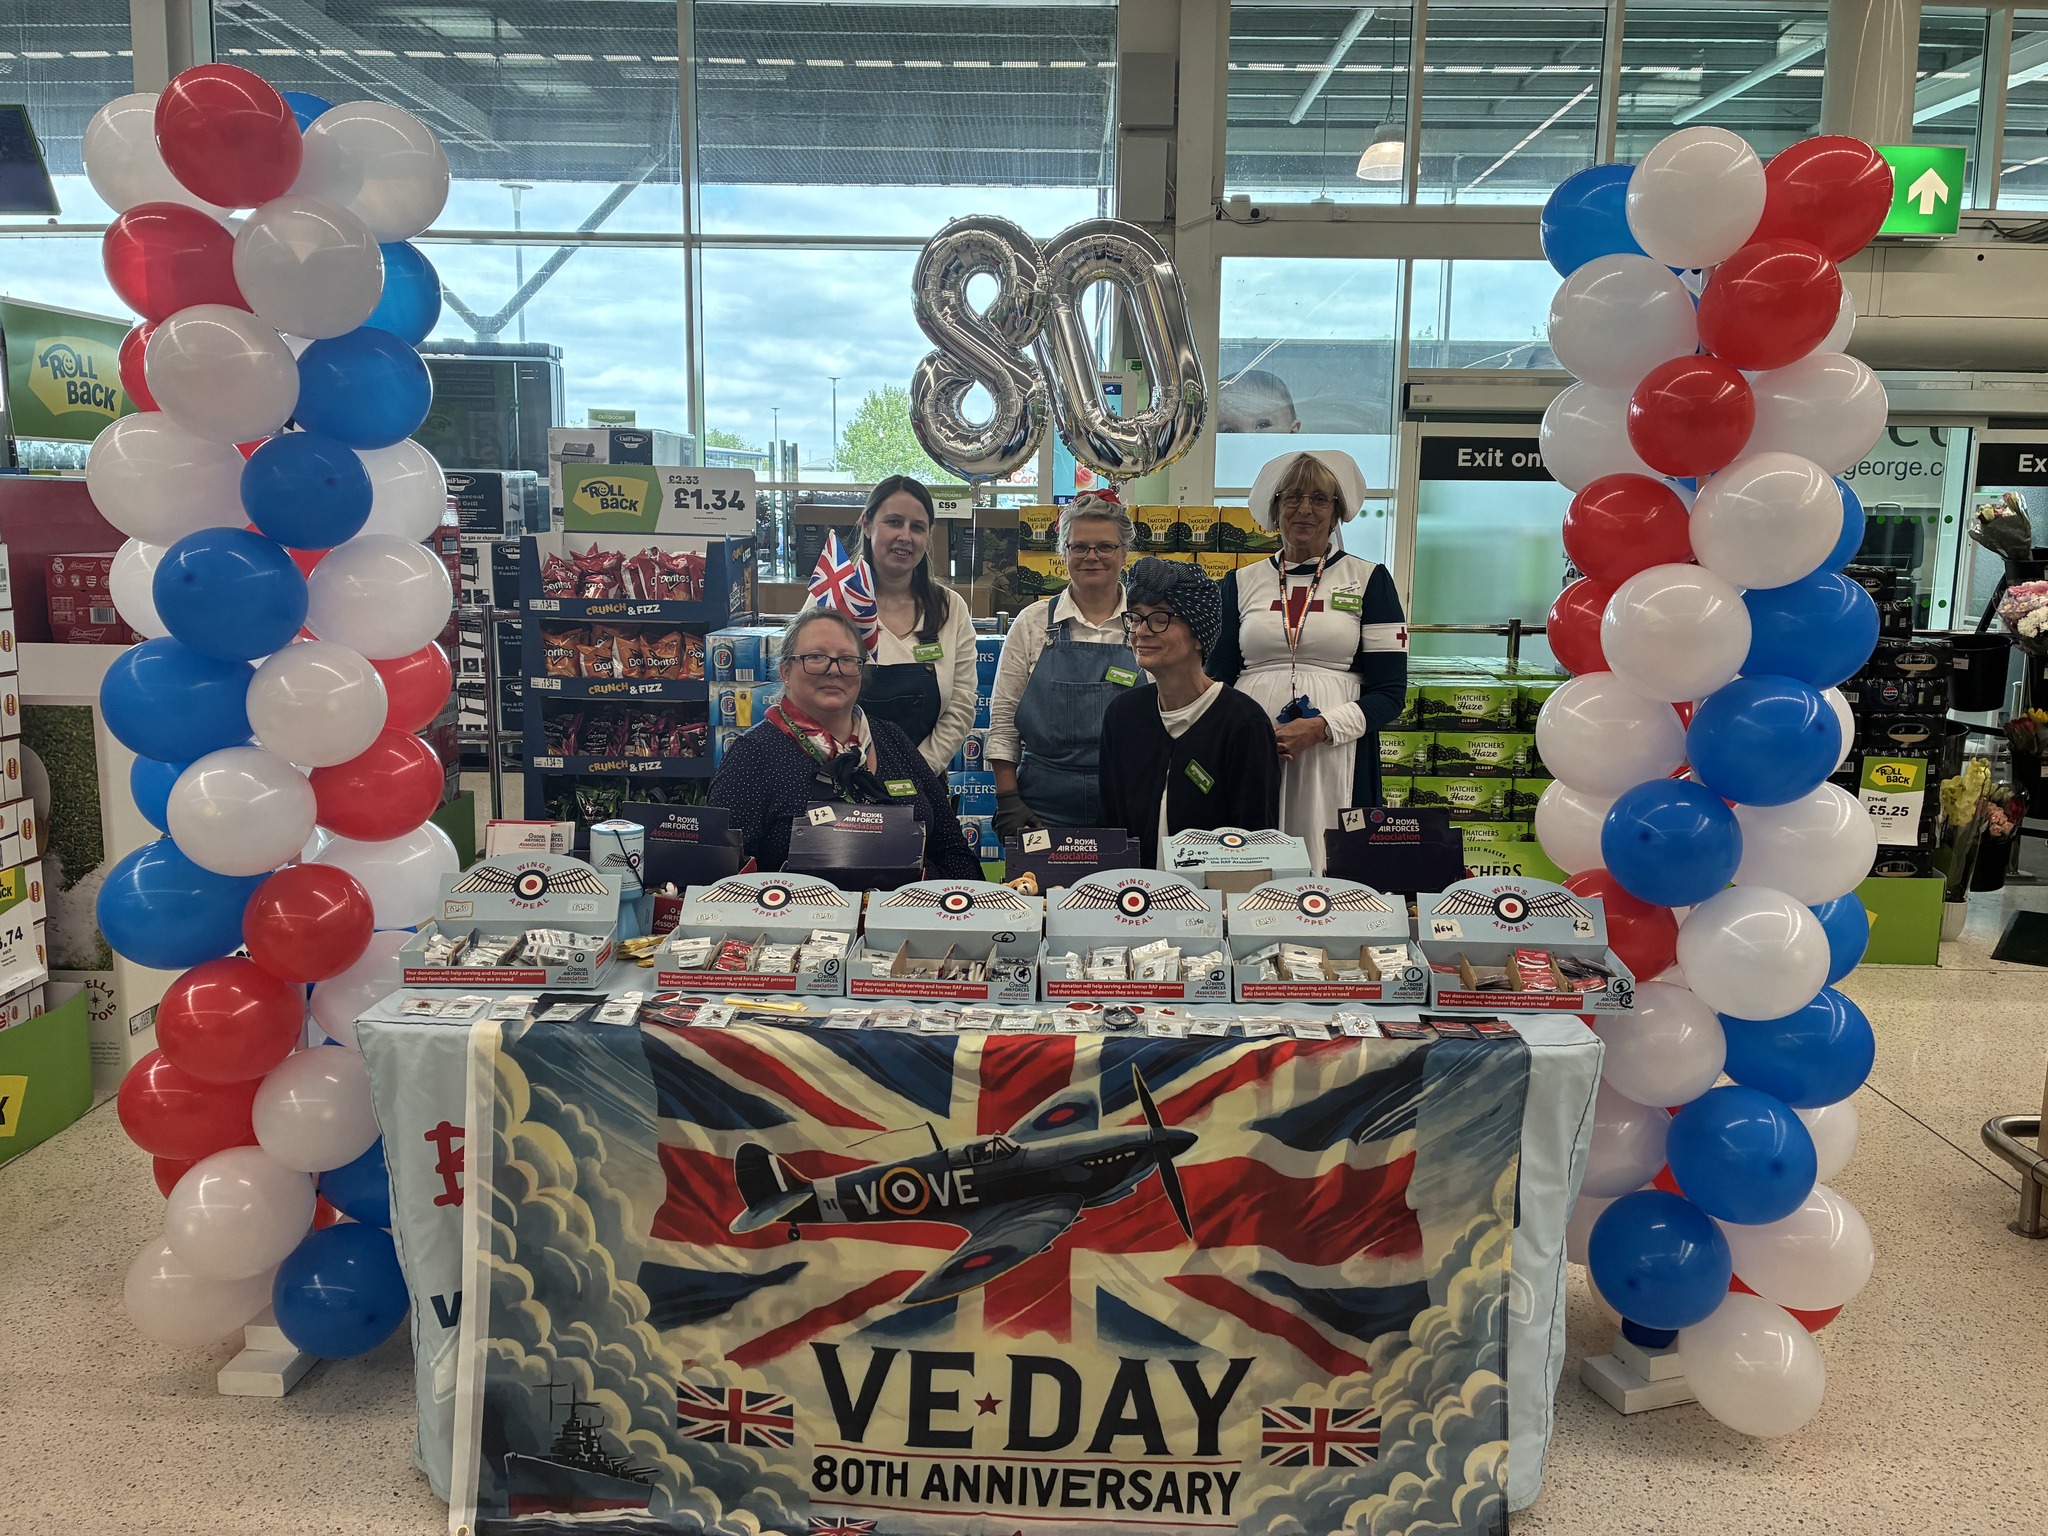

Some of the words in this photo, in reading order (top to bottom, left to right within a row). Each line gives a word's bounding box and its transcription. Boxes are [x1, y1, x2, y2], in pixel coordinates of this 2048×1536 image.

[910, 214, 1208, 482] 80
[50, 351, 98, 380] ROLL
[1457, 447, 1503, 467] Exit
[1511, 452, 1546, 468] on
[1843, 459, 1945, 480] george.c
[667, 475, 700, 485] £2.33
[589, 483, 625, 499] ROLL
[674, 487, 746, 511] £1.34
[938, 501, 957, 509] £59
[1031, 522, 1047, 530] Gold
[1151, 523, 1167, 532] Gold
[1192, 523, 1208, 532] Gold
[660, 573, 690, 584] Doritos
[1207, 570, 1223, 578] Gold
[586, 603, 626, 616] CRUNCH
[627, 606, 636, 616] &
[637, 604, 660, 614] FIZZ
[647, 656, 679, 667] Doritos
[588, 682, 628, 695] CRUNCH
[629, 686, 638, 695] &
[638, 683, 662, 694] FIZZ
[1453, 694, 1490, 702] THATCHERS
[1456, 701, 1484, 711] Haze
[1467, 741, 1505, 749] THATCHERS
[1470, 748, 1498, 758] Haze
[588, 760, 628, 772] CRUNCH
[629, 763, 638, 772] &
[638, 761, 662, 772] FIZZ
[1880, 767, 1902, 776] ROLL
[949, 784, 996, 794] FOSTER'S
[1445, 784, 1483, 792] THATCHERS
[1449, 792, 1476, 801] Haze
[1868, 805, 1909, 817] £5.25
[677, 816, 699, 825] ROYAL
[834, 821, 883, 830] Association
[659, 821, 672, 829] AIR
[673, 823, 699, 831] FORCES
[650, 829, 698, 839] Association
[1369, 833, 1420, 841] Association
[1026, 833, 1042, 846] £2
[516, 861, 552, 873] WINGS
[760, 879, 795, 888] WINGS
[1117, 878, 1151, 889] WINGS
[1296, 884, 1331, 893] WINGS
[942, 885, 976, 894] WINGS
[1491, 885, 1528, 896] WINGS
[508, 897, 550, 909] APPEAL
[572, 903, 594, 911] £1.50
[447, 904, 468, 914] £1.50
[752, 907, 792, 918] APPEAL
[696, 913, 718, 921] £1.50
[812, 912, 834, 920] £1.50
[935, 911, 976, 921] APPEAL
[1009, 910, 1030, 921] £1.50
[1114, 914, 1154, 926] APPEAL
[1296, 915, 1337, 926] APPEAL
[1255, 916, 1277, 927] £1.50
[1367, 919, 1388, 931] £1.50
[1491, 920, 1535, 933] APPEAL
[1434, 924, 1454, 934] NEW
[85, 979, 115, 999] ELLA
[1092, 983, 1102, 991] help
[1103, 983, 1120, 991] serving
[1158, 984, 1183, 992] personnel
[1070, 989, 1090, 997] families,
[1115, 989, 1125, 997] they
[88, 1002, 117, 1022] TOIS
[809, 1341, 975, 1449] VE
[1002, 1353, 1258, 1457] DAY
[811, 1454, 908, 1498] 80TH
[920, 1462, 1241, 1516] ANNIVERSARY
